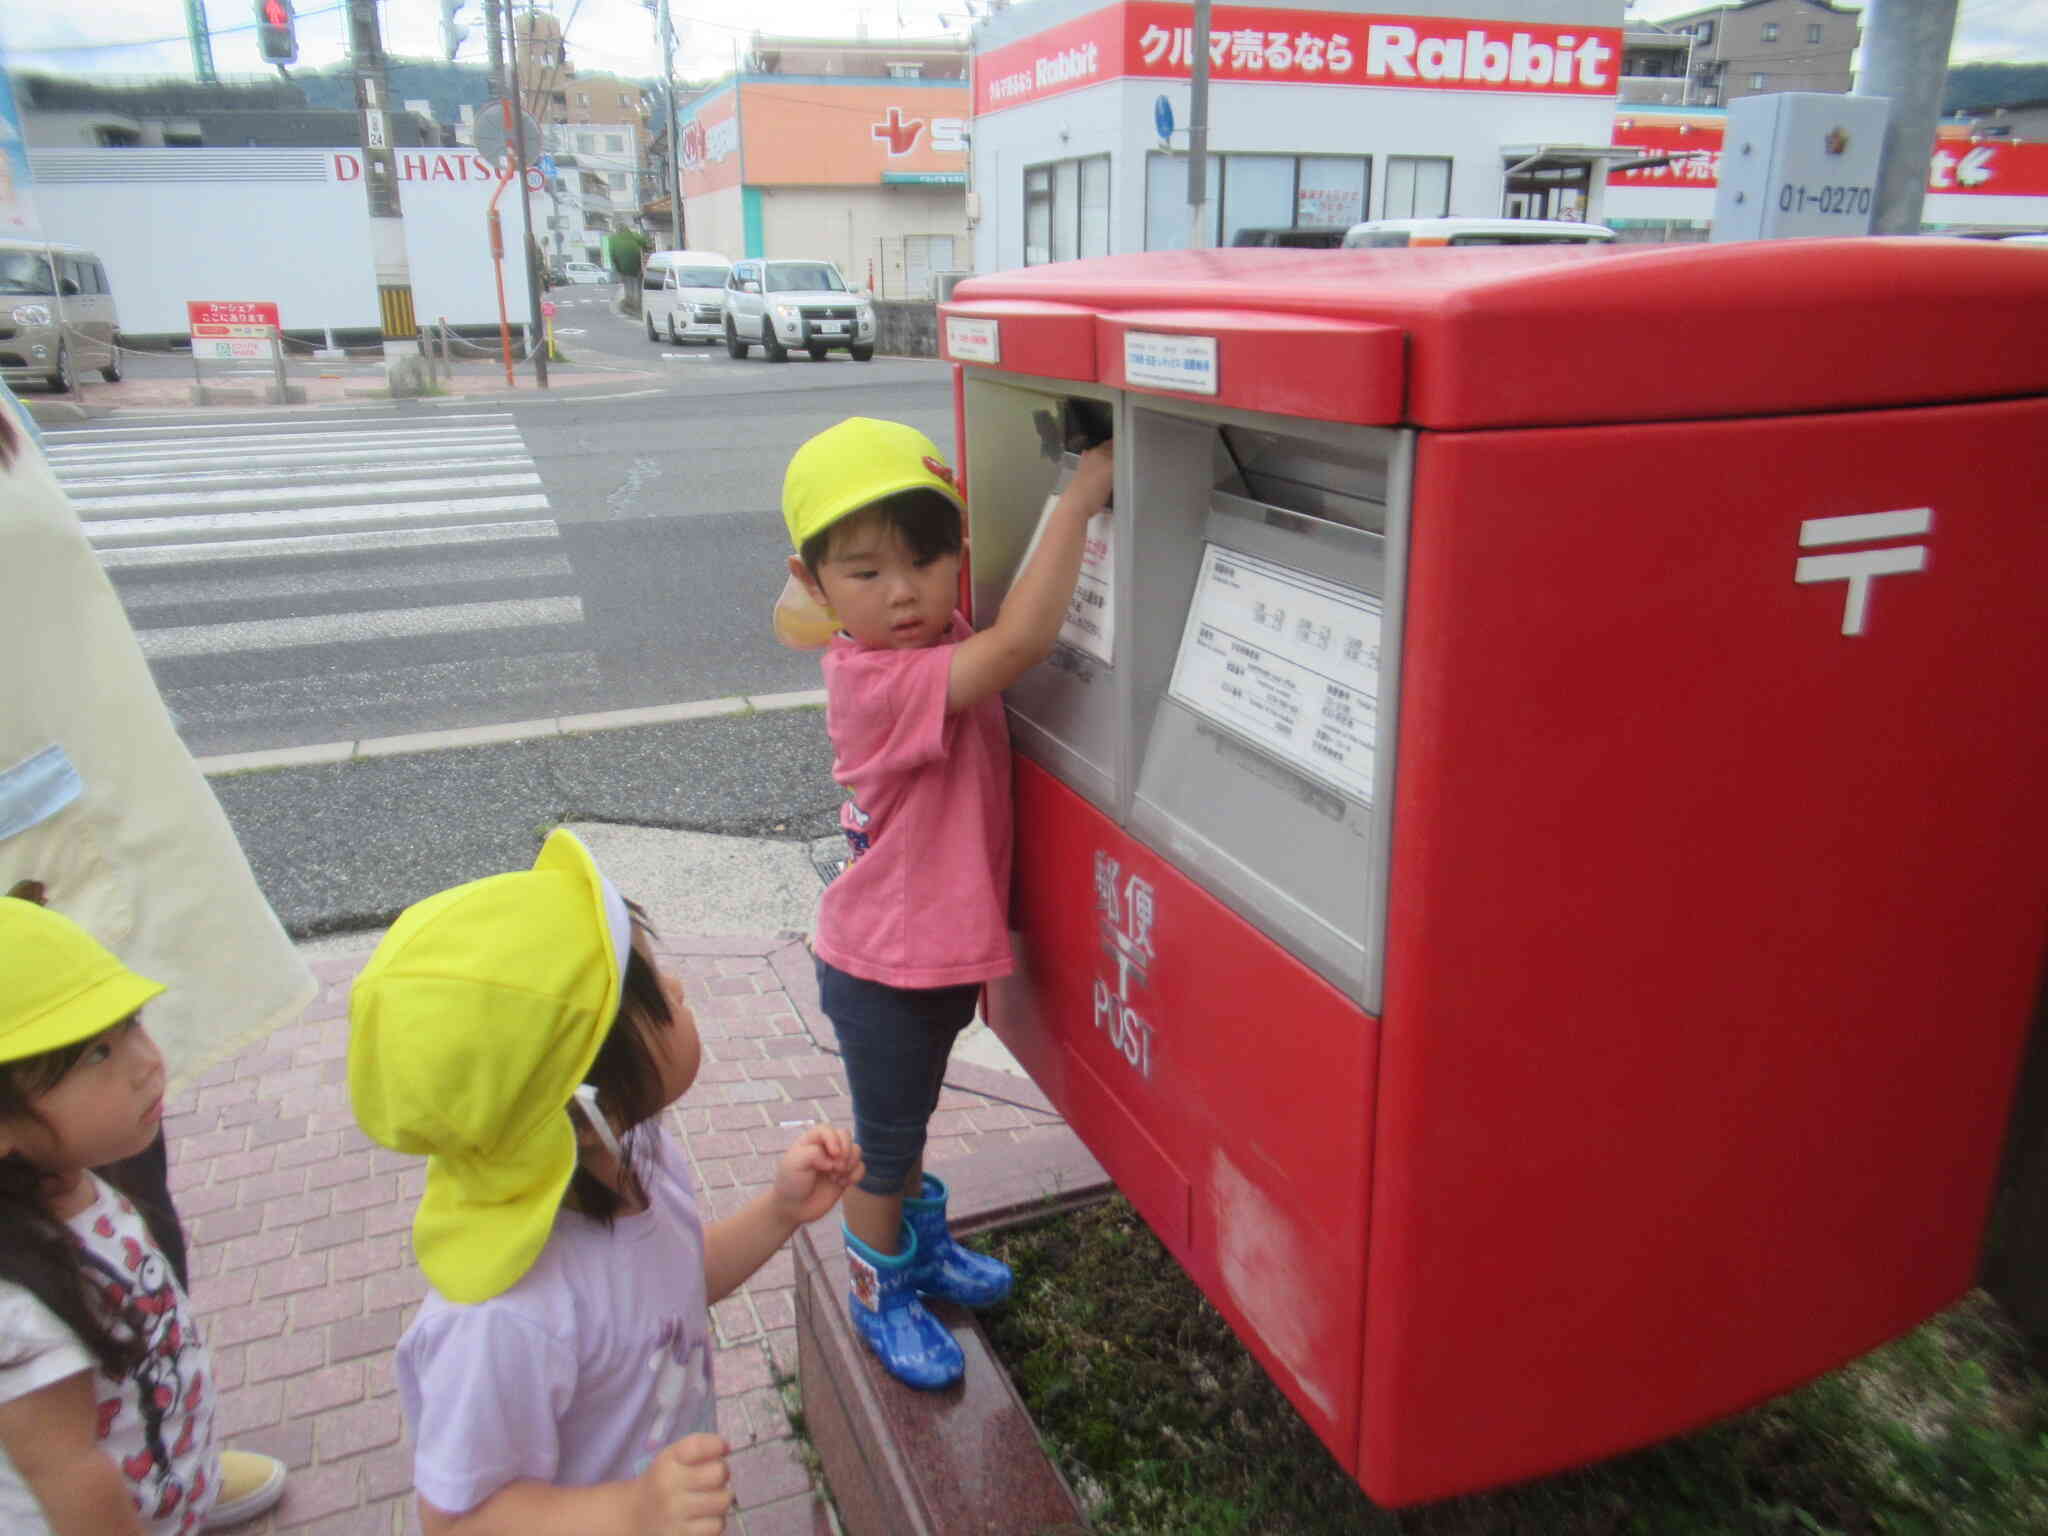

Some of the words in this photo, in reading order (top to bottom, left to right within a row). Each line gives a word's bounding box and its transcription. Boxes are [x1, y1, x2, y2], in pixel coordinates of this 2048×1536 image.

[1035, 41, 1098, 89] Rabbit
[1139, 25, 1354, 72] クルマ売るなら
[1366, 24, 1610, 86] Rabbit
[334, 154, 515, 182] DHATS
[1779, 184, 1870, 215] 01-0270
